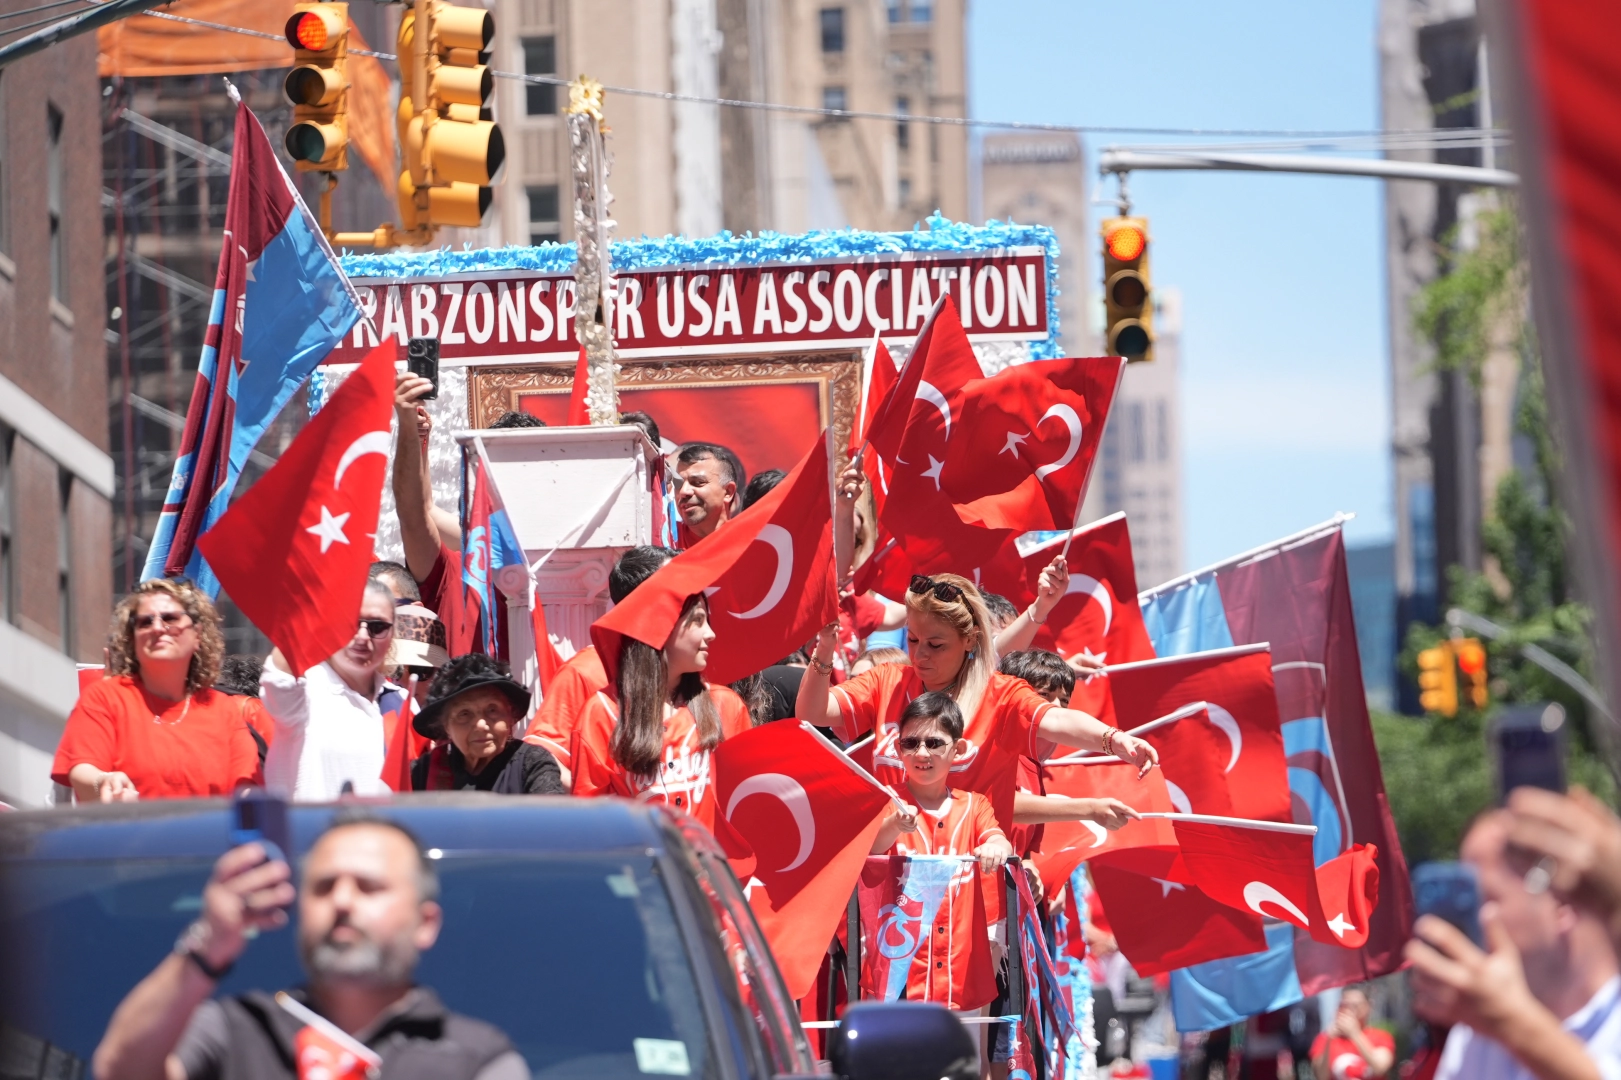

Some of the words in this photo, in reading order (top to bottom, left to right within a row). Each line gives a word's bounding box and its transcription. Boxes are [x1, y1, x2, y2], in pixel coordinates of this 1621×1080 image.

[334, 277, 646, 349] RABZONSPR
[656, 273, 743, 339] USA
[753, 263, 1038, 334] ASSOCIATION
